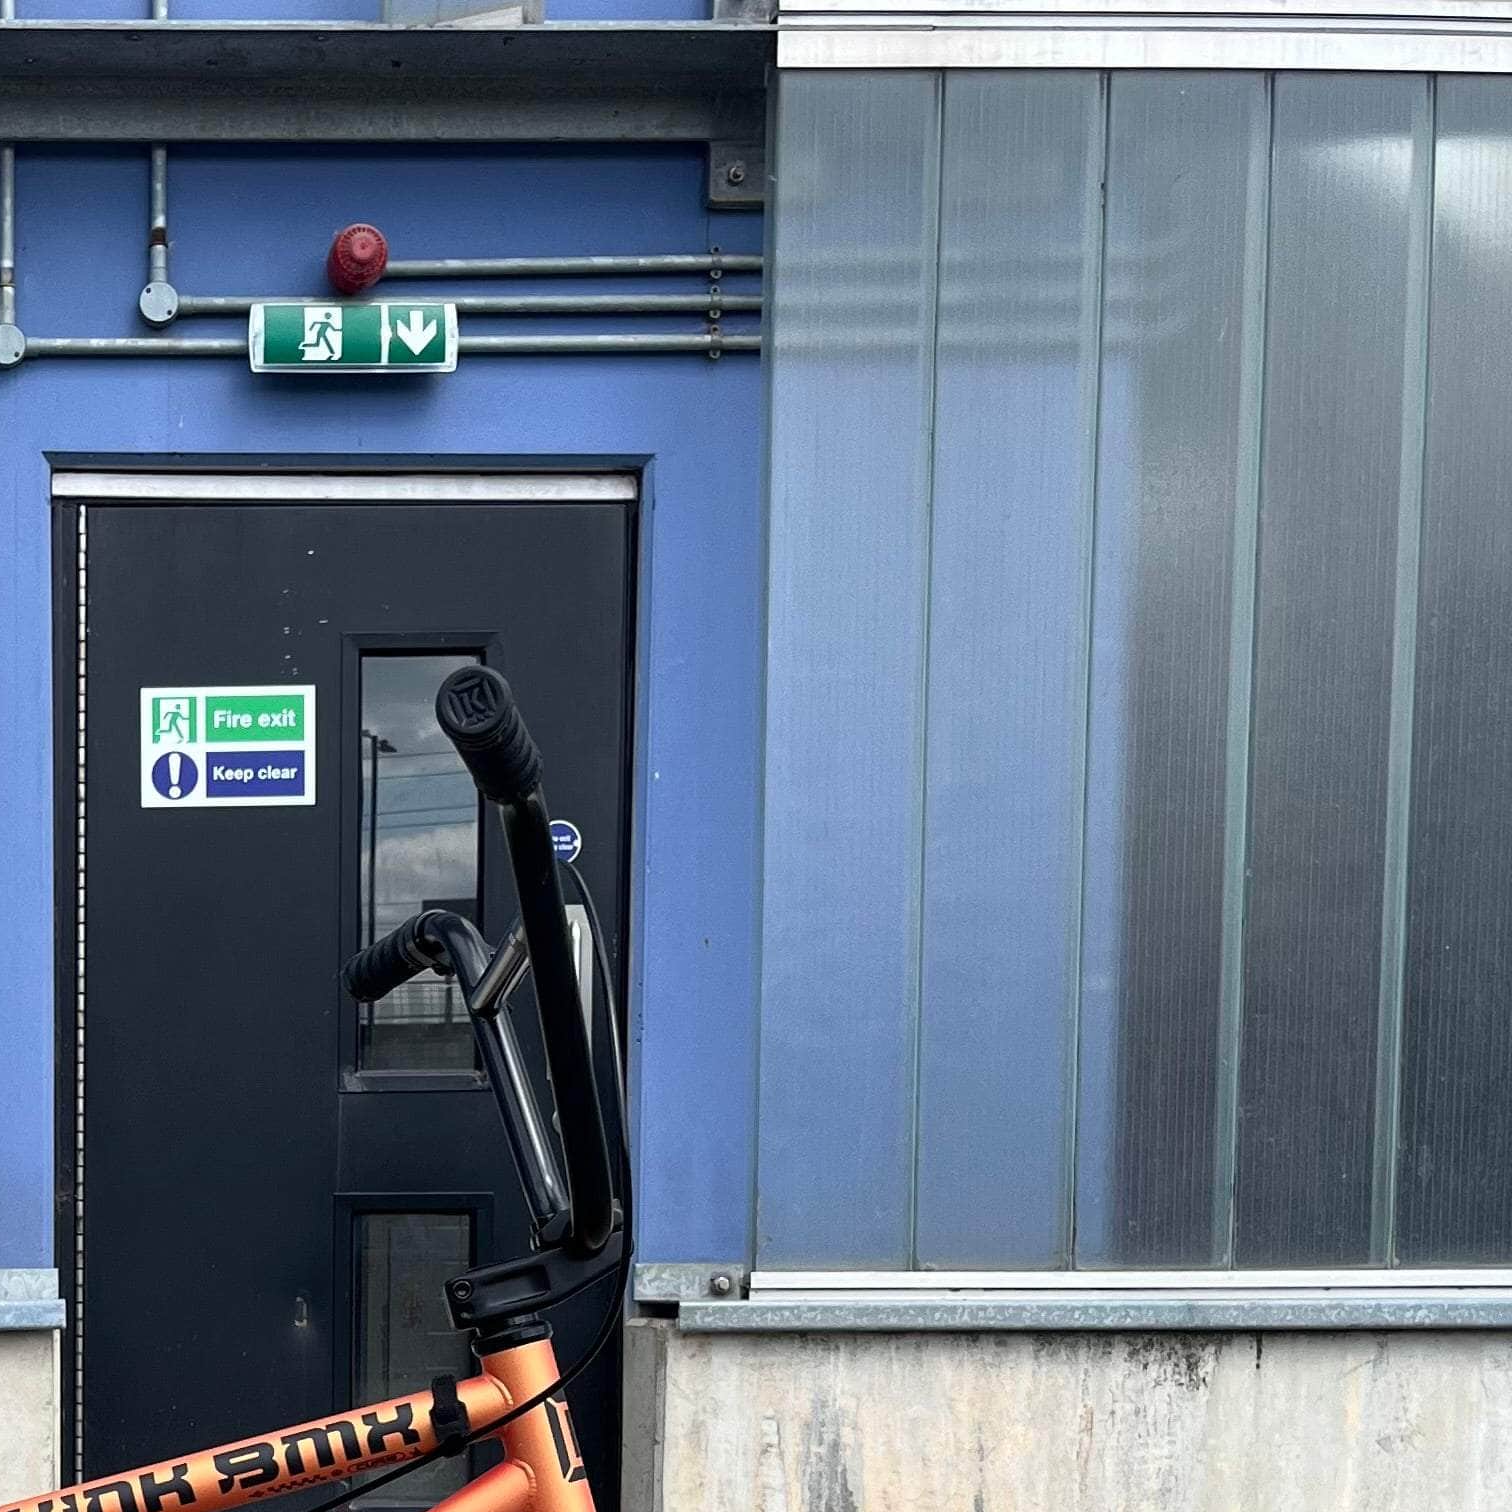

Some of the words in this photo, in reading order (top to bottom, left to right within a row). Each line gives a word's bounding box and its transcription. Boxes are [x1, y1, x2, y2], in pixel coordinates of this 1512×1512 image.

[213, 710, 253, 729] Fire
[257, 708, 297, 727] exit
[212, 766, 254, 783] Keep
[257, 765, 298, 780] clear
[212, 1402, 420, 1495] BMX
